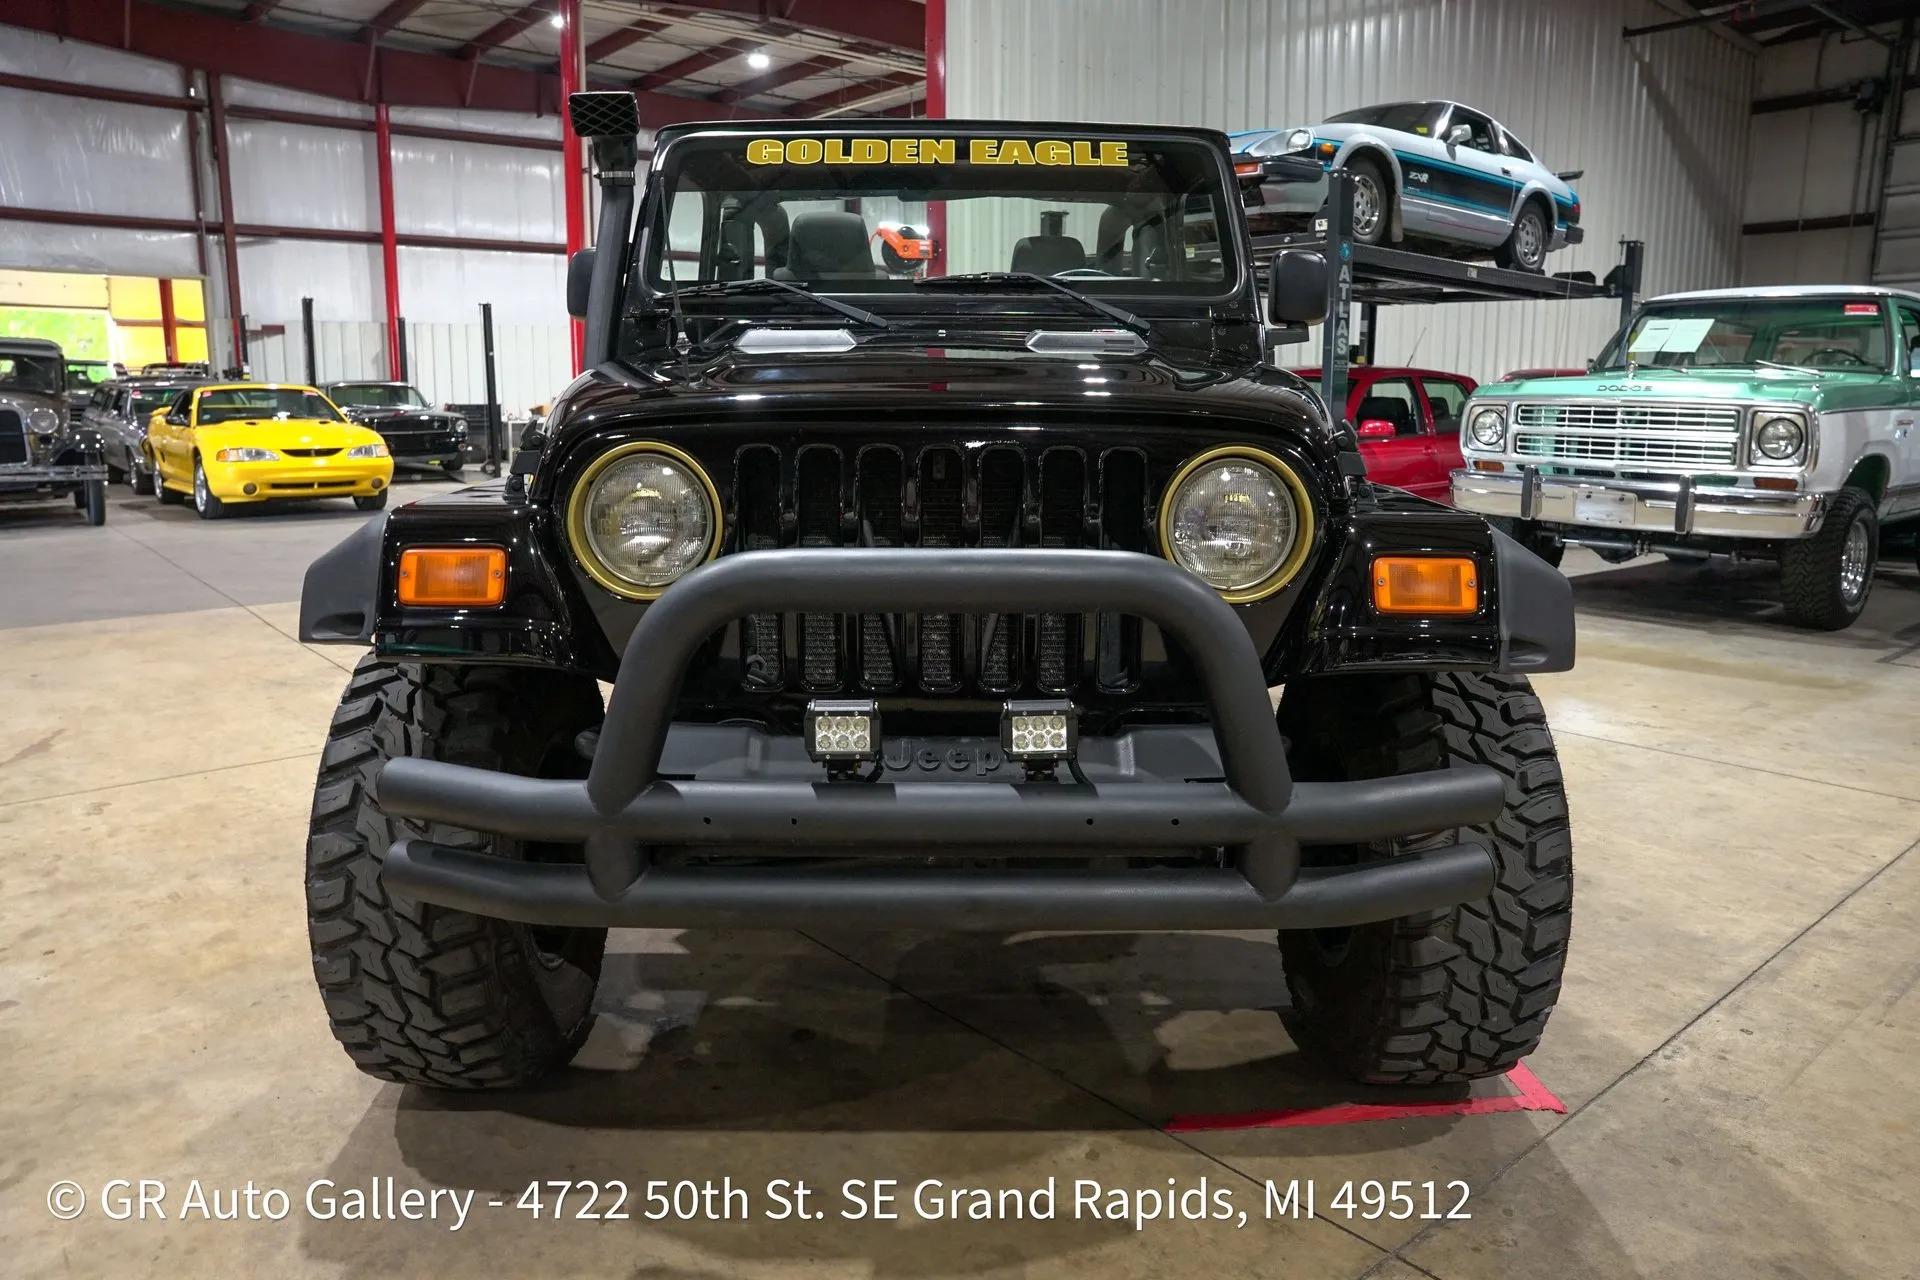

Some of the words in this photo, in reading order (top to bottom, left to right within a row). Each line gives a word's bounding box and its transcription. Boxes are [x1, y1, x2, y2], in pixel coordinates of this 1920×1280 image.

[746, 138, 956, 165] GOLDEN
[969, 139, 1129, 167] EAGLE
[1335, 264, 1351, 355] ATLAS
[884, 739, 1001, 777] Jeep
